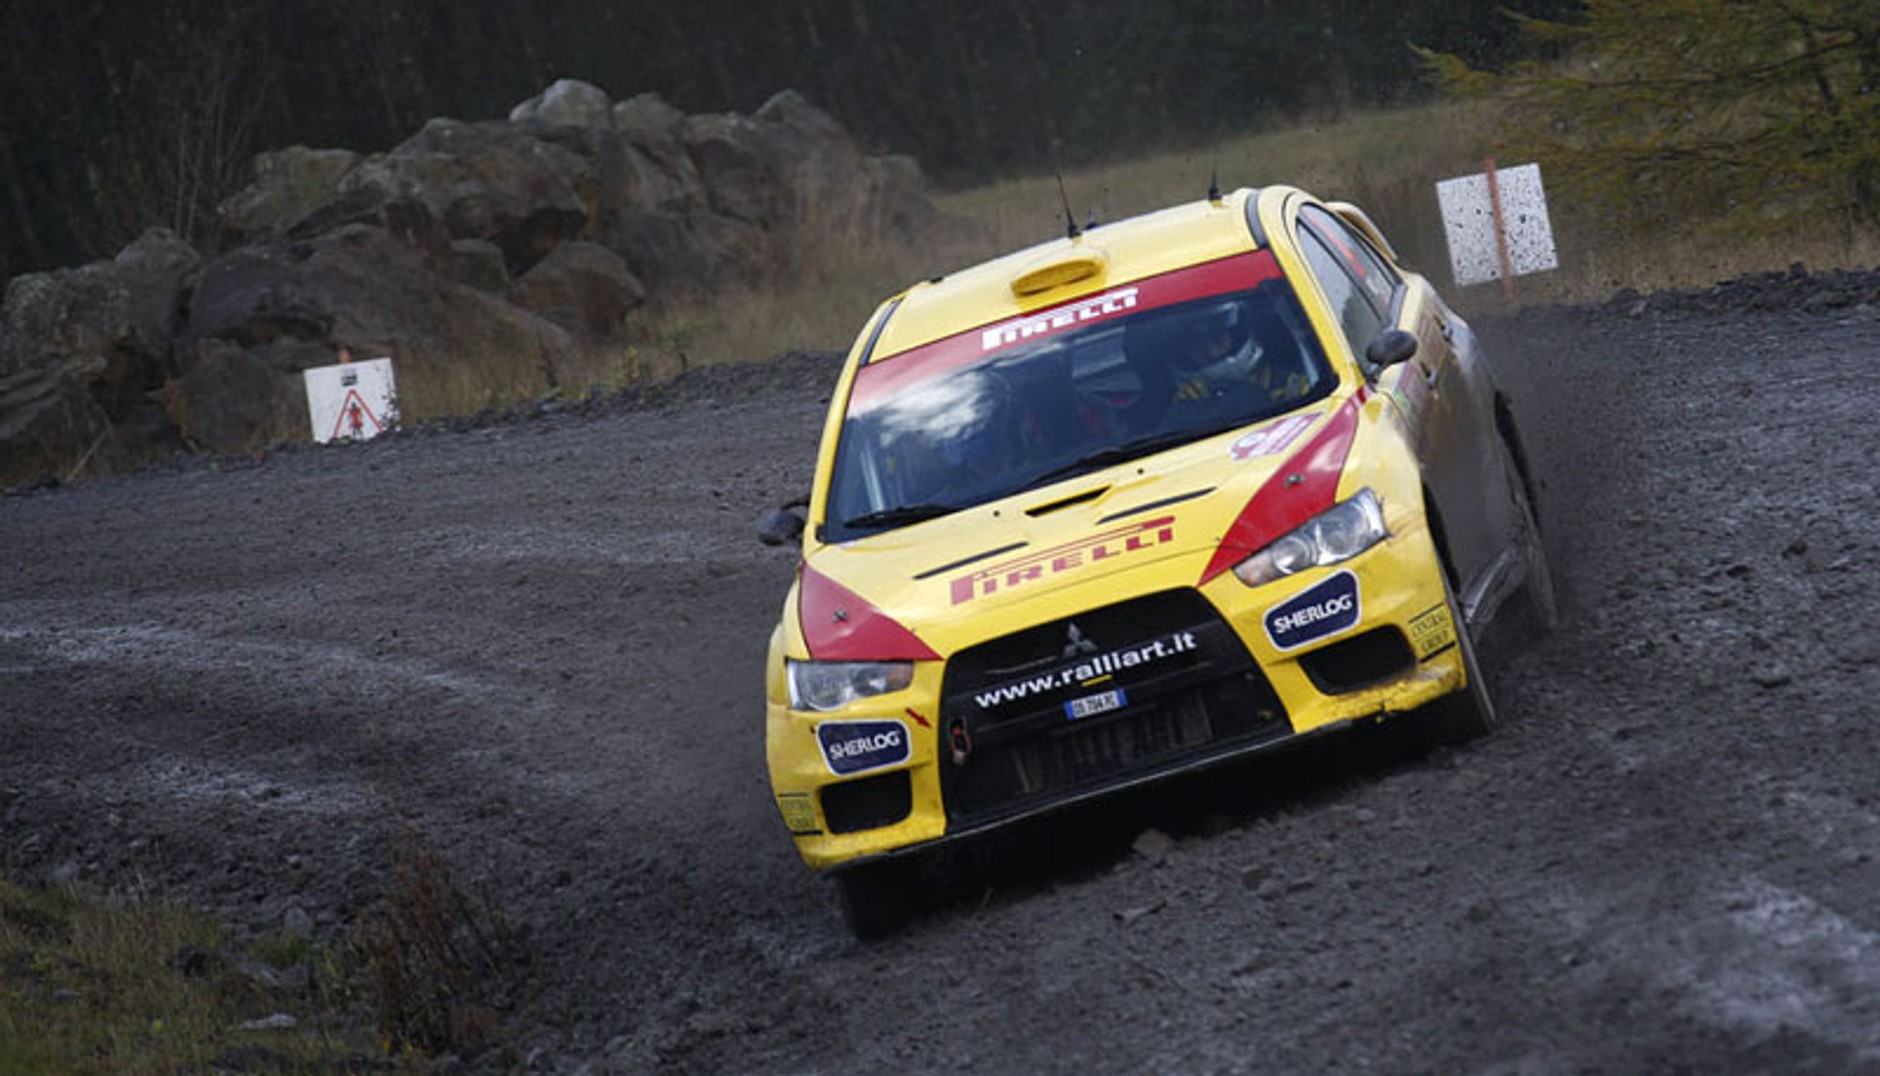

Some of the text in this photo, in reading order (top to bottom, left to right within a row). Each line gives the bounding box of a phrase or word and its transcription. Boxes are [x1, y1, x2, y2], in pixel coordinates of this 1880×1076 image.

[982, 286, 1139, 351] PIRELLI
[950, 515, 1175, 606] PIRELLI
[1273, 592, 1353, 635] SHERLOG
[829, 731, 900, 760] SHERLOG
